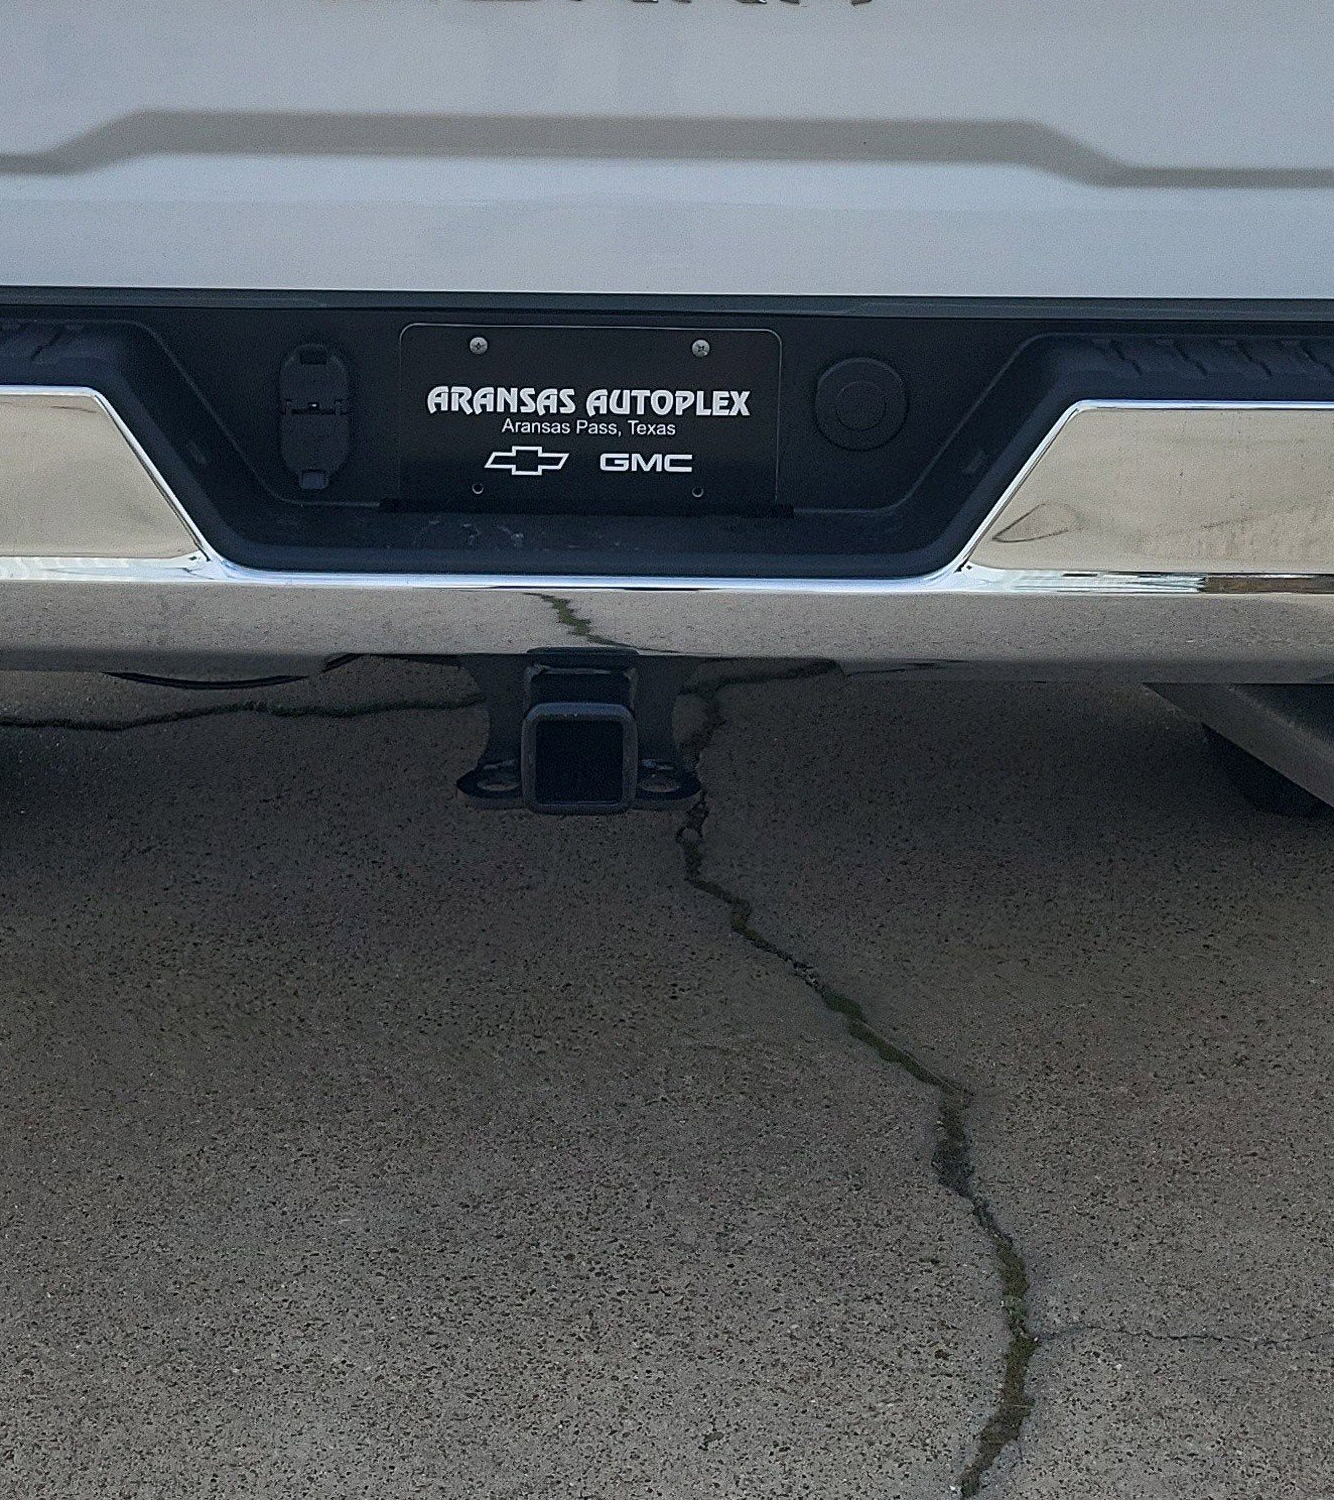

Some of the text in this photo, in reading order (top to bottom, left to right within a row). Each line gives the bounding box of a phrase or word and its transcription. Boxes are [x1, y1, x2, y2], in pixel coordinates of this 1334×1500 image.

[427, 385, 751, 417] ARANSAS AUTOPLEX
[501, 417, 676, 437] Aransas Pass, Texas
[599, 452, 693, 473] GMC
